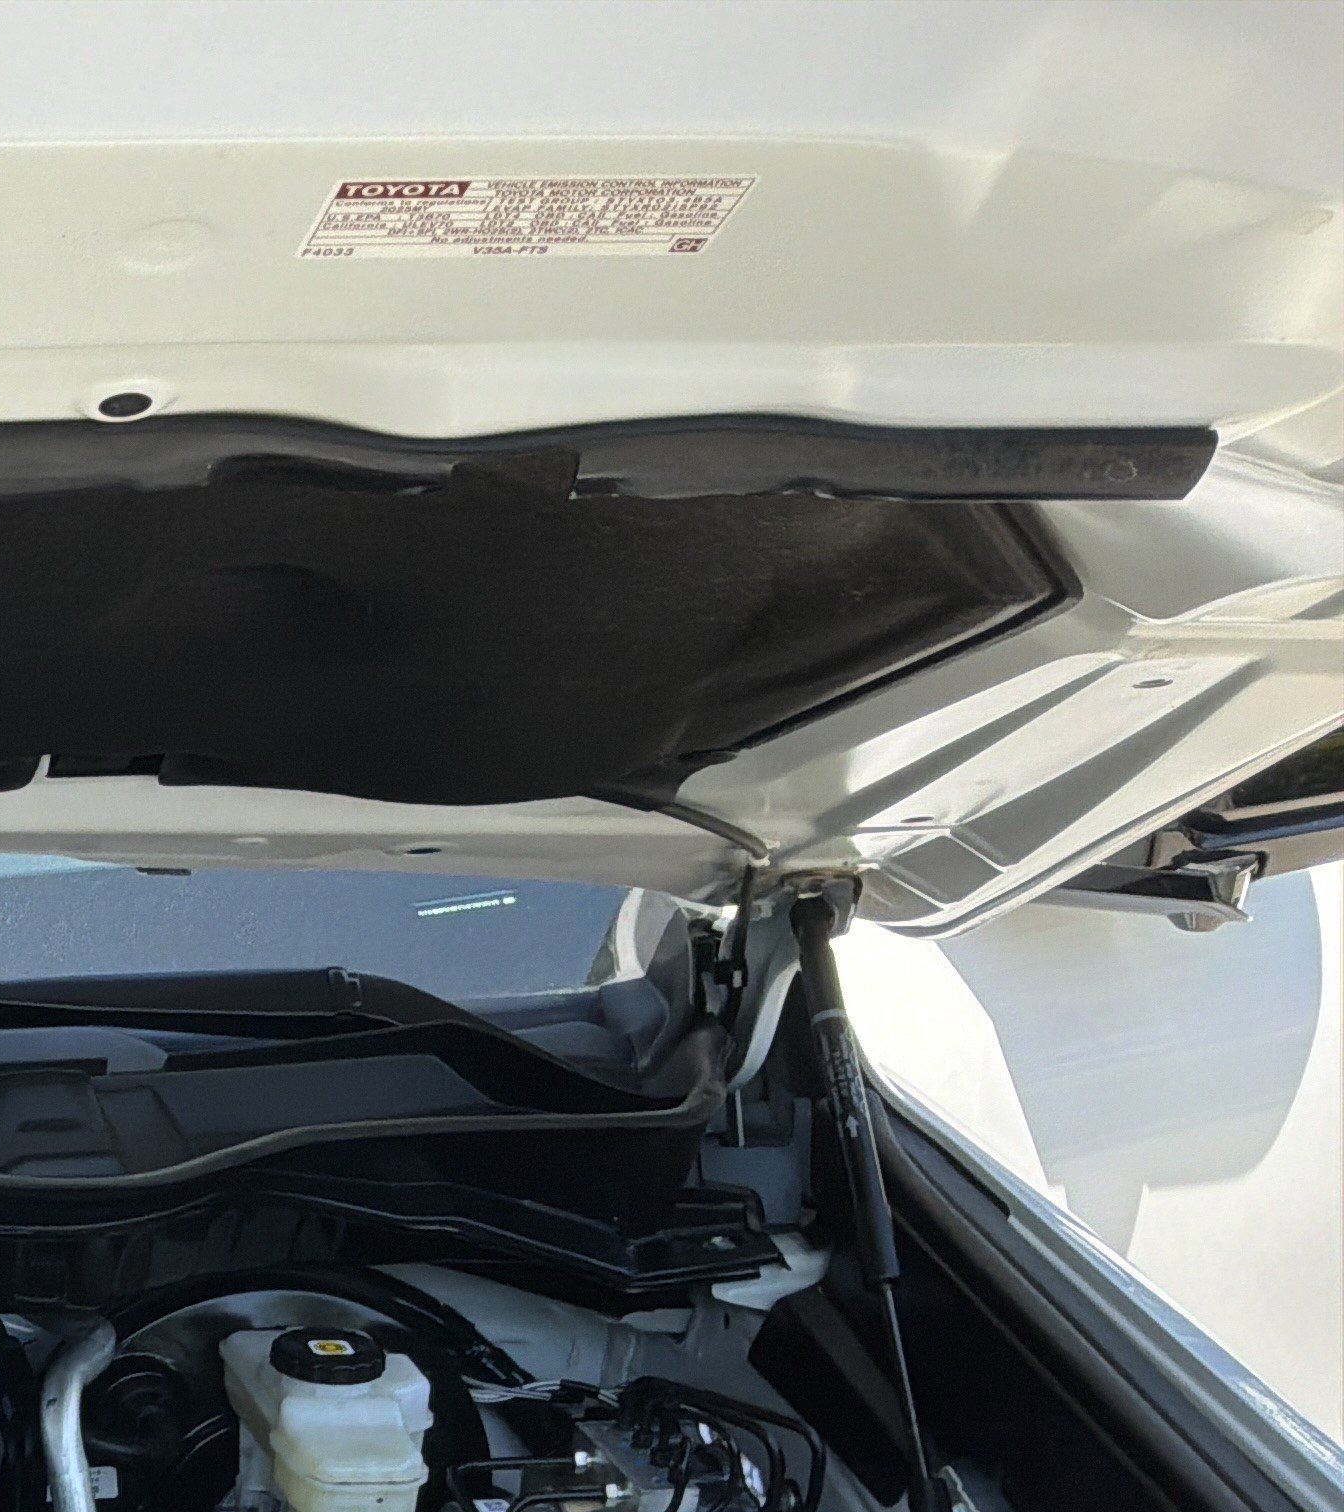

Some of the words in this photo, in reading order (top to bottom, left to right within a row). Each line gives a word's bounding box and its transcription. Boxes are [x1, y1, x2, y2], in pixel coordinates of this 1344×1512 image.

[487, 180, 538, 188] VEHICLE
[539, 180, 598, 188] EMISSION
[601, 179, 657, 187] CONTROL
[661, 179, 743, 187] INFORMATION
[344, 184, 460, 196] TOYOTA
[453, 235, 533, 243] adjustments
[303, 247, 355, 256] F4033
